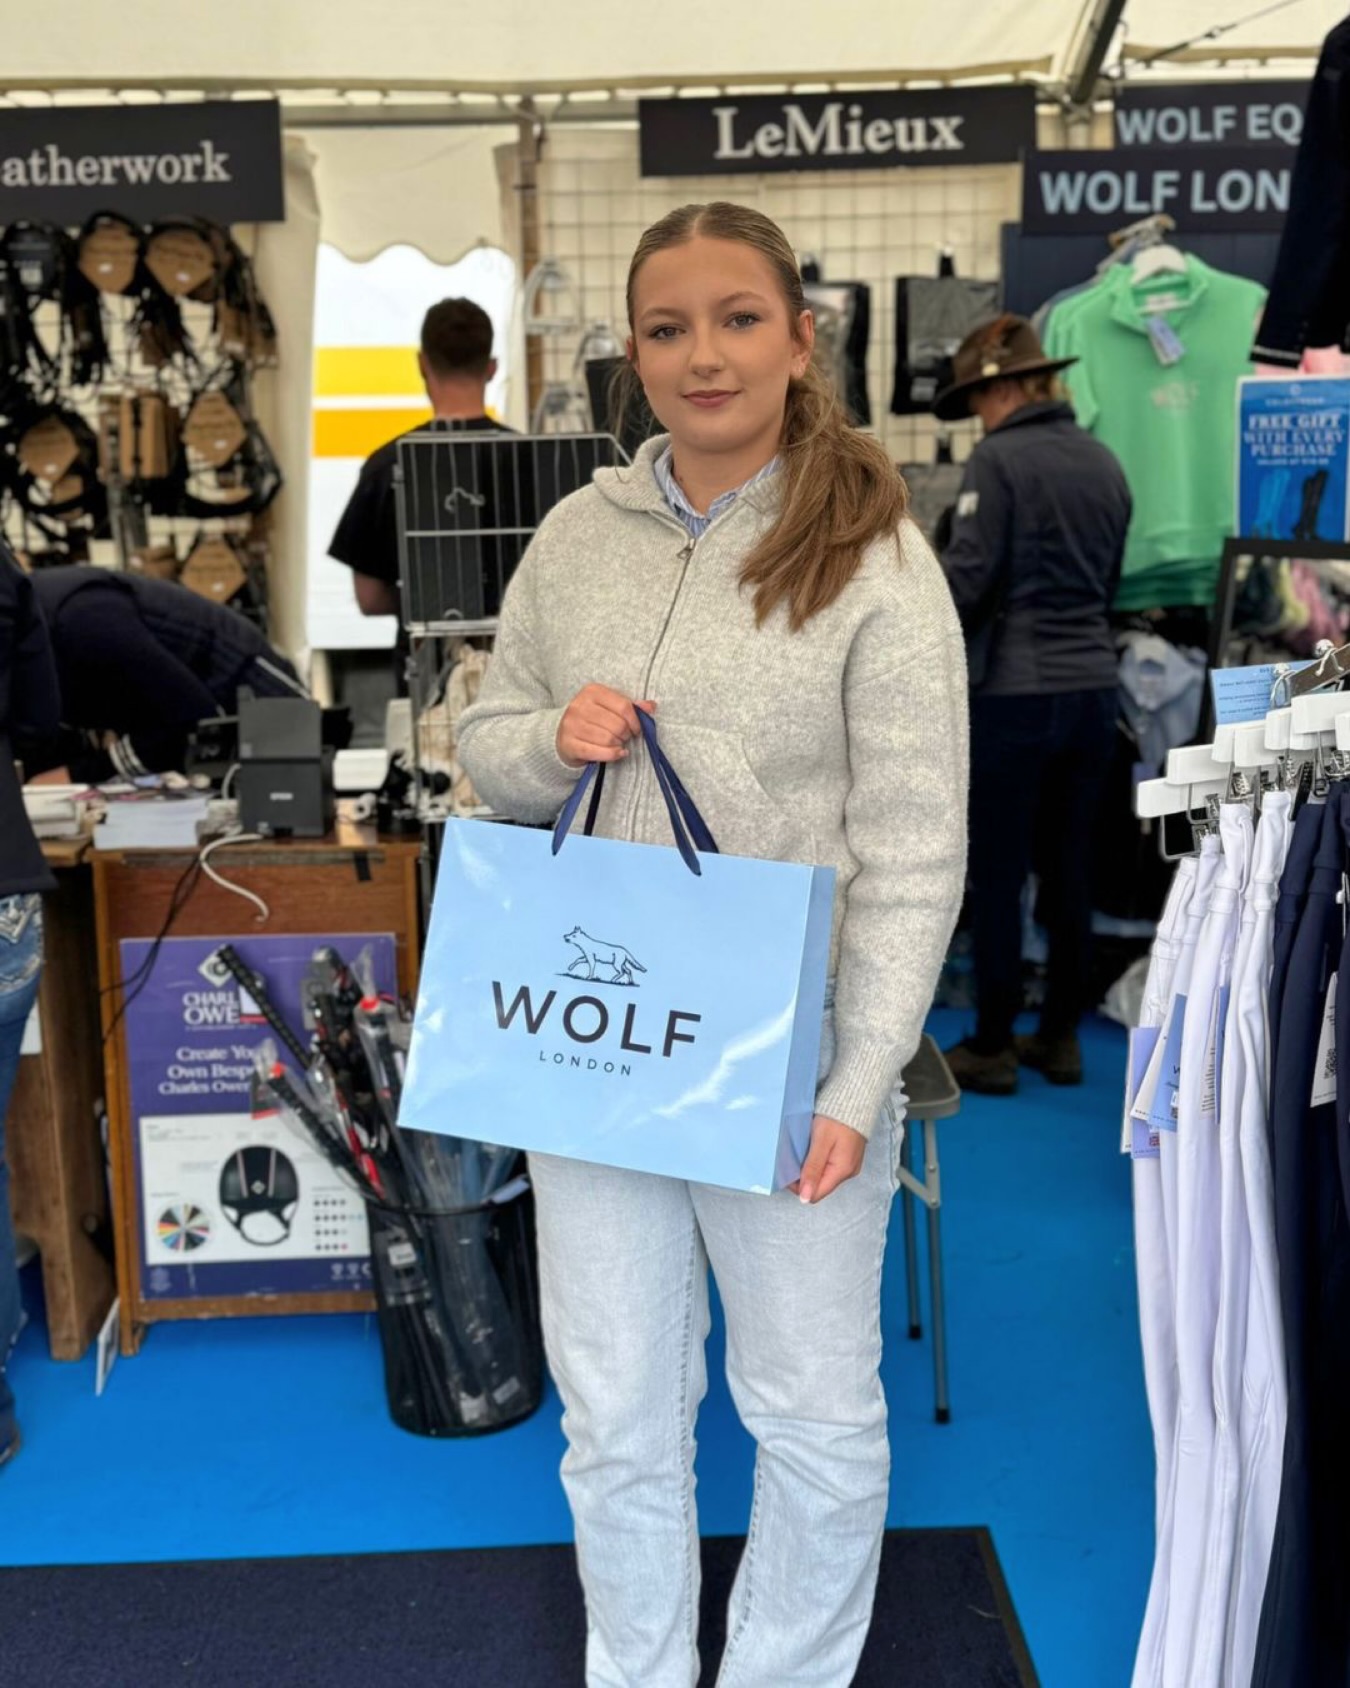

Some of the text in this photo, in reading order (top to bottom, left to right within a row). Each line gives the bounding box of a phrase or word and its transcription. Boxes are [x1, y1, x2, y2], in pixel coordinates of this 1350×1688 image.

[713, 102, 964, 160] LeMieux
[1118, 107, 1237, 144] WOLF
[1, 140, 231, 186] atherwork
[1040, 169, 1291, 214] WOLF LON
[1249, 413, 1341, 430] FREE GIFT
[1245, 430, 1344, 444] WITH EVERY
[1251, 444, 1336, 457] PURCHASE
[492, 981, 702, 1057] WOLF
[176, 1046, 227, 1062] Create
[539, 1050, 632, 1077] LONDON
[167, 1064, 208, 1079] Own
[159, 1081, 209, 1095] Charles
